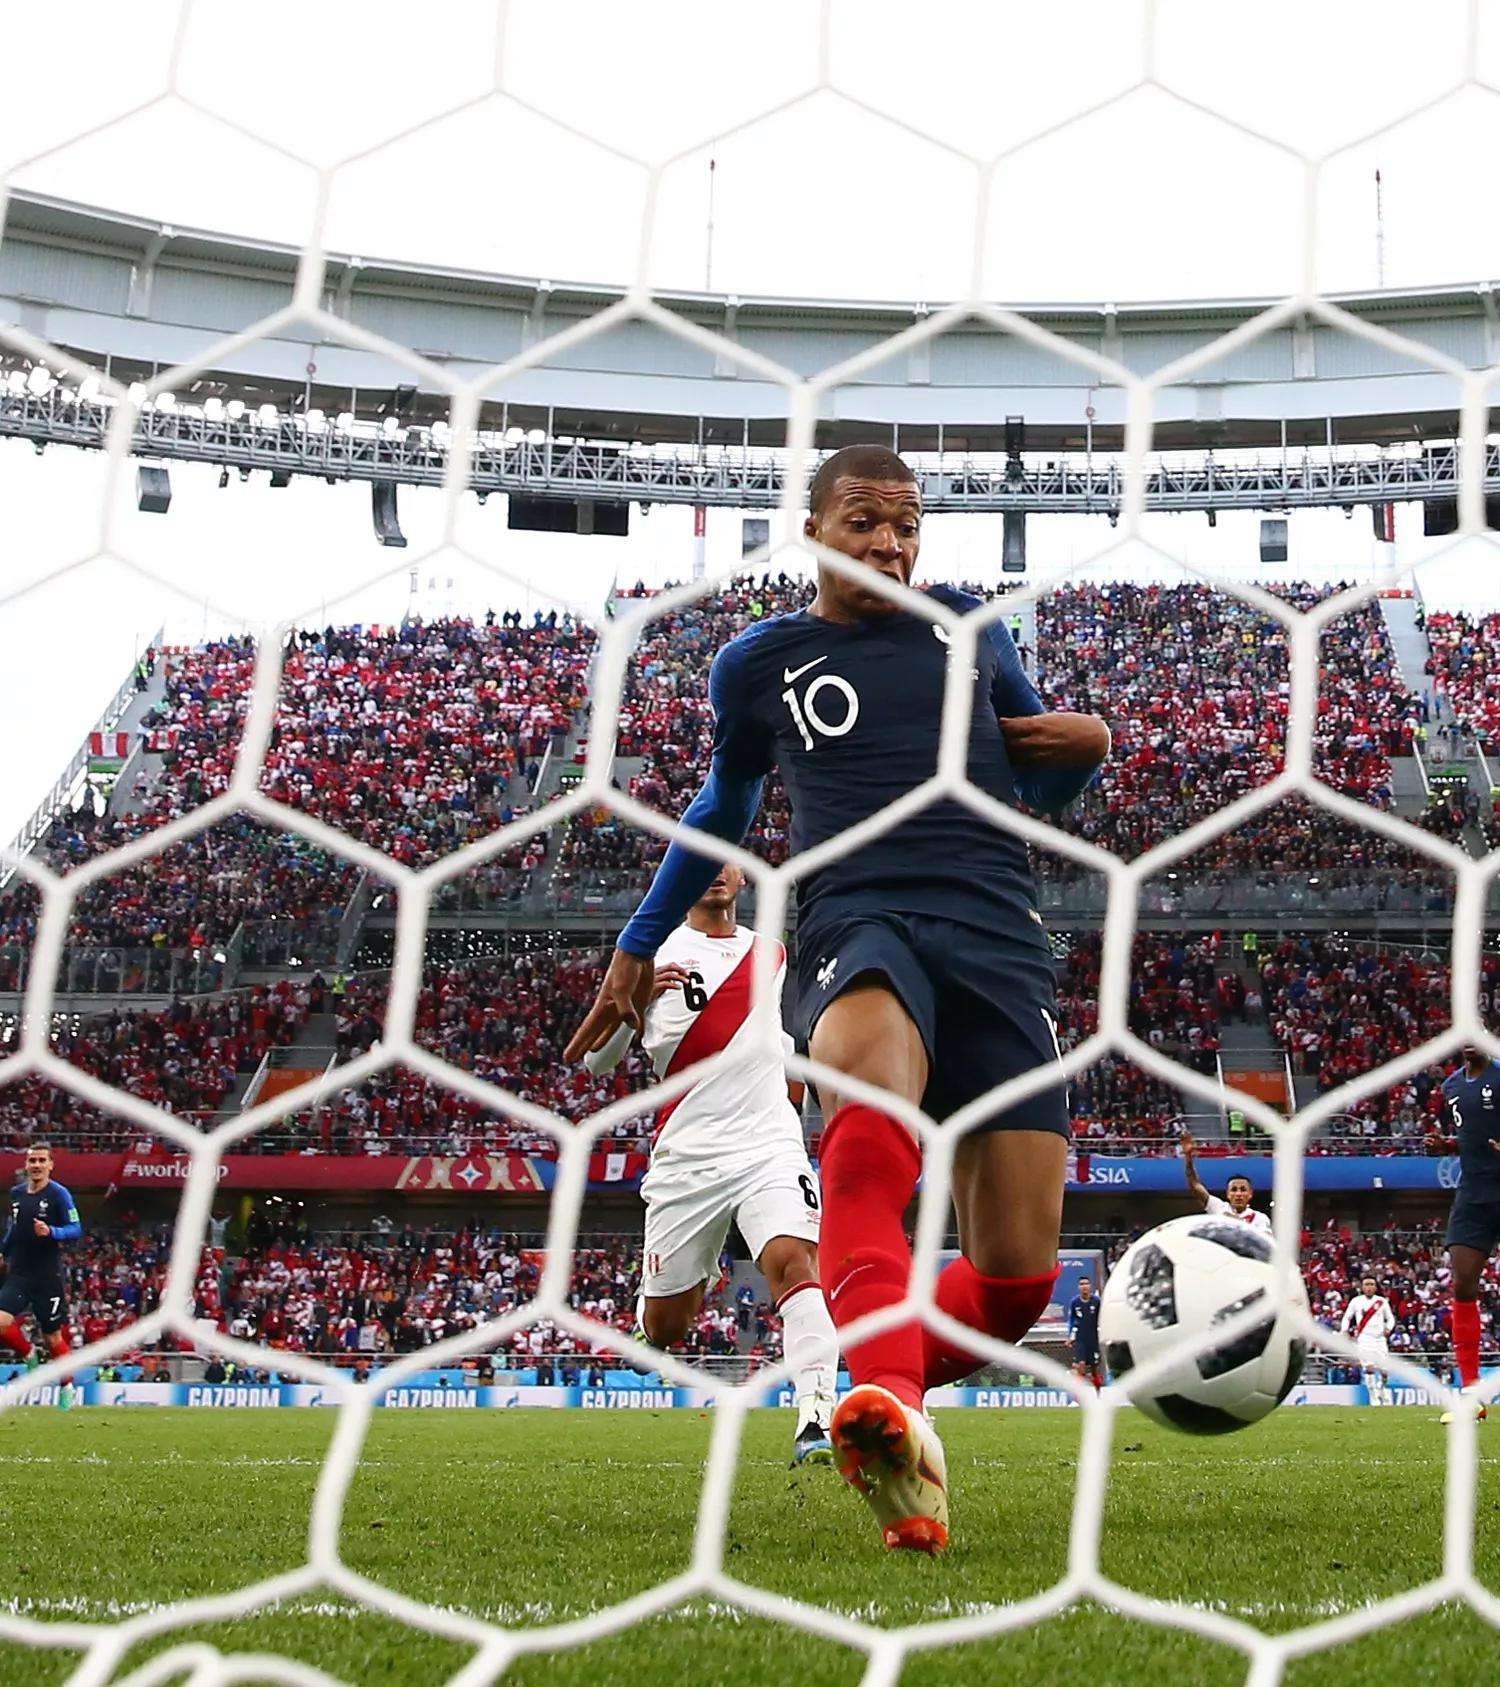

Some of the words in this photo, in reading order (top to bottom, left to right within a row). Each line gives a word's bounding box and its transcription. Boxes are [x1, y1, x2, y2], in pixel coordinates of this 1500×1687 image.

[782, 674, 859, 752] 10
[682, 971, 708, 1012] 6
[1452, 1104, 1463, 1127] 6
[123, 1160, 229, 1182] #worldp
[50, 1297, 61, 1314] 7
[188, 1387, 280, 1407] GAZPROM
[384, 1389, 477, 1408] GAZPROM
[582, 1390, 674, 1409] GAZPROM
